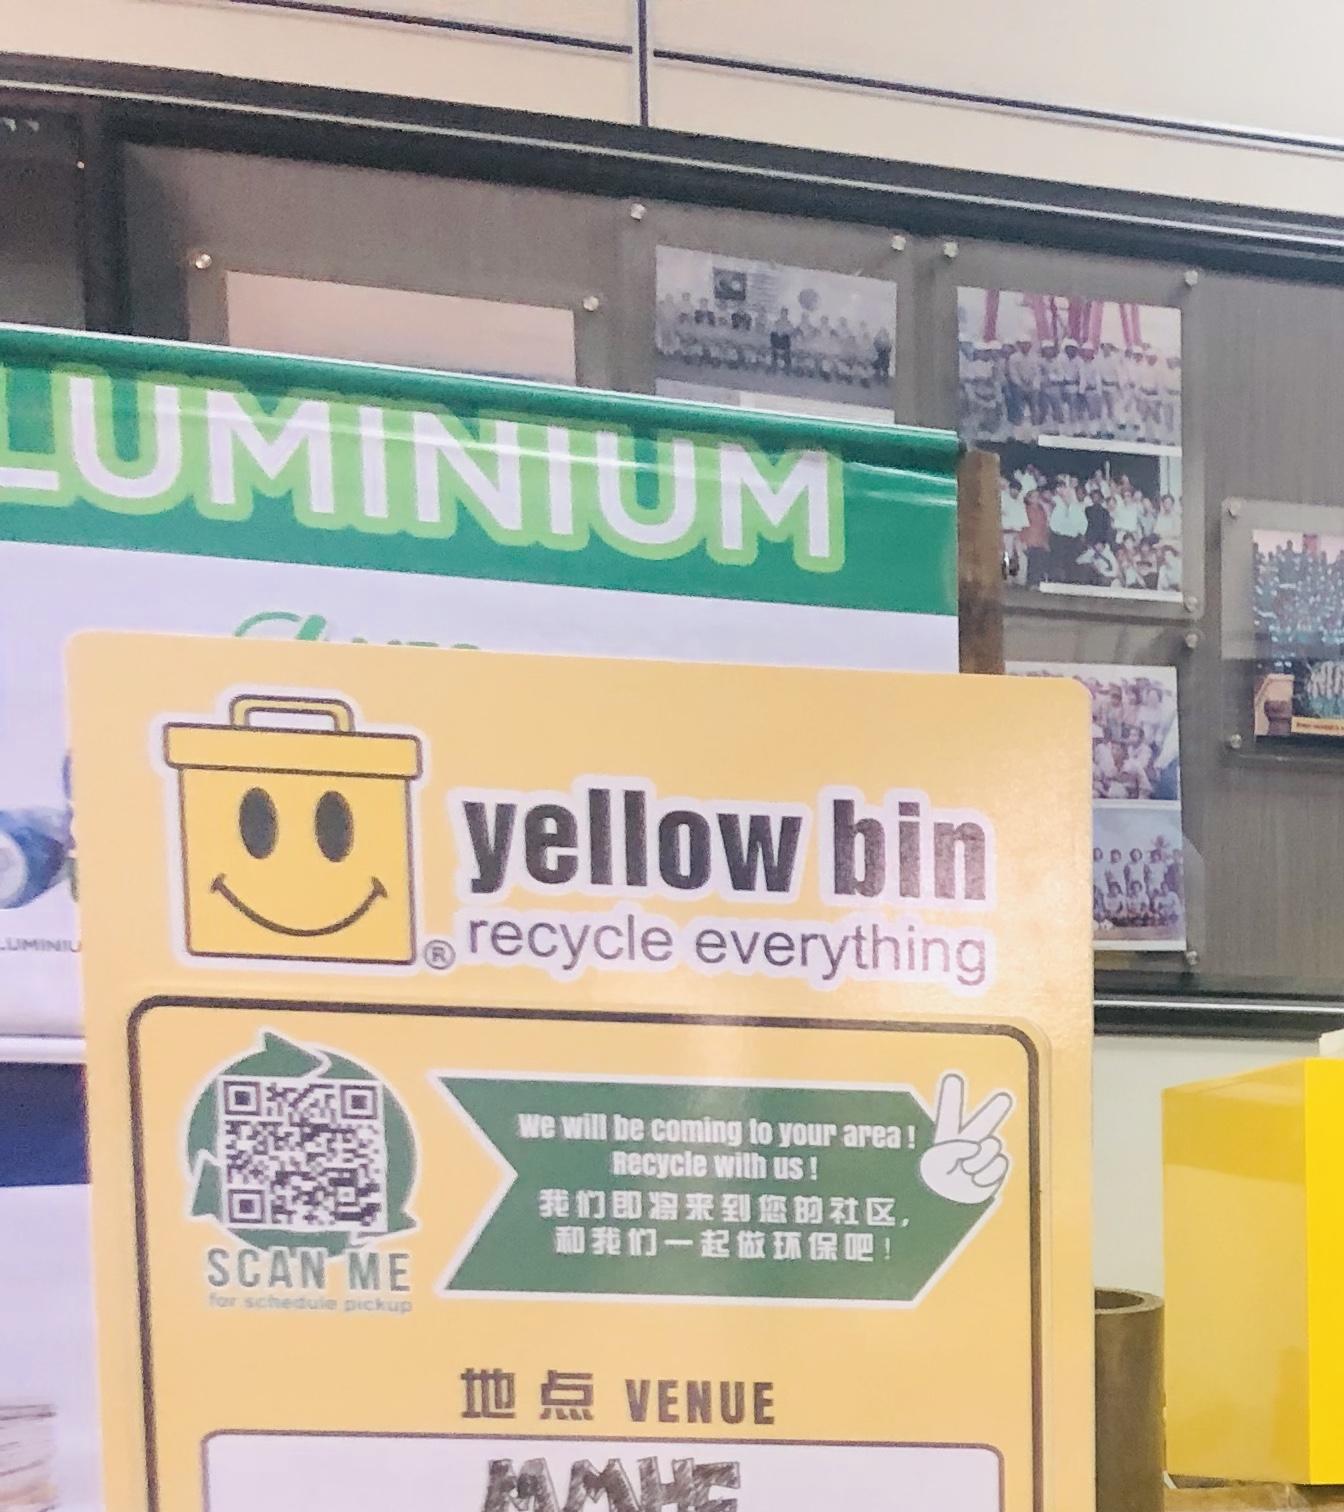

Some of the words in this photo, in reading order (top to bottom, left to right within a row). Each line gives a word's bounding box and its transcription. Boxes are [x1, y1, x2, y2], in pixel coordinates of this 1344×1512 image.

[461, 787, 803, 893] yellow
[832, 798, 987, 900] bin
[468, 914, 674, 971] recycle
[694, 923, 987, 986] everything
[518, 1113, 555, 1140] We
[561, 1113, 606, 1141] will
[614, 1115, 644, 1141] be
[651, 1116, 741, 1147] coming
[750, 1119, 771, 1145] to
[779, 1122, 837, 1149] your
[612, 1153, 707, 1181] Recycle
[714, 1152, 766, 1180] with
[206, 1247, 326, 1289] SCAN
[350, 1251, 411, 1292] ME
[209, 1294, 236, 1308] for
[243, 1294, 338, 1311] schedule
[344, 1297, 412, 1314] pickup
[460, 1368, 594, 1421] 地点
[626, 1378, 775, 1425] VENUE
